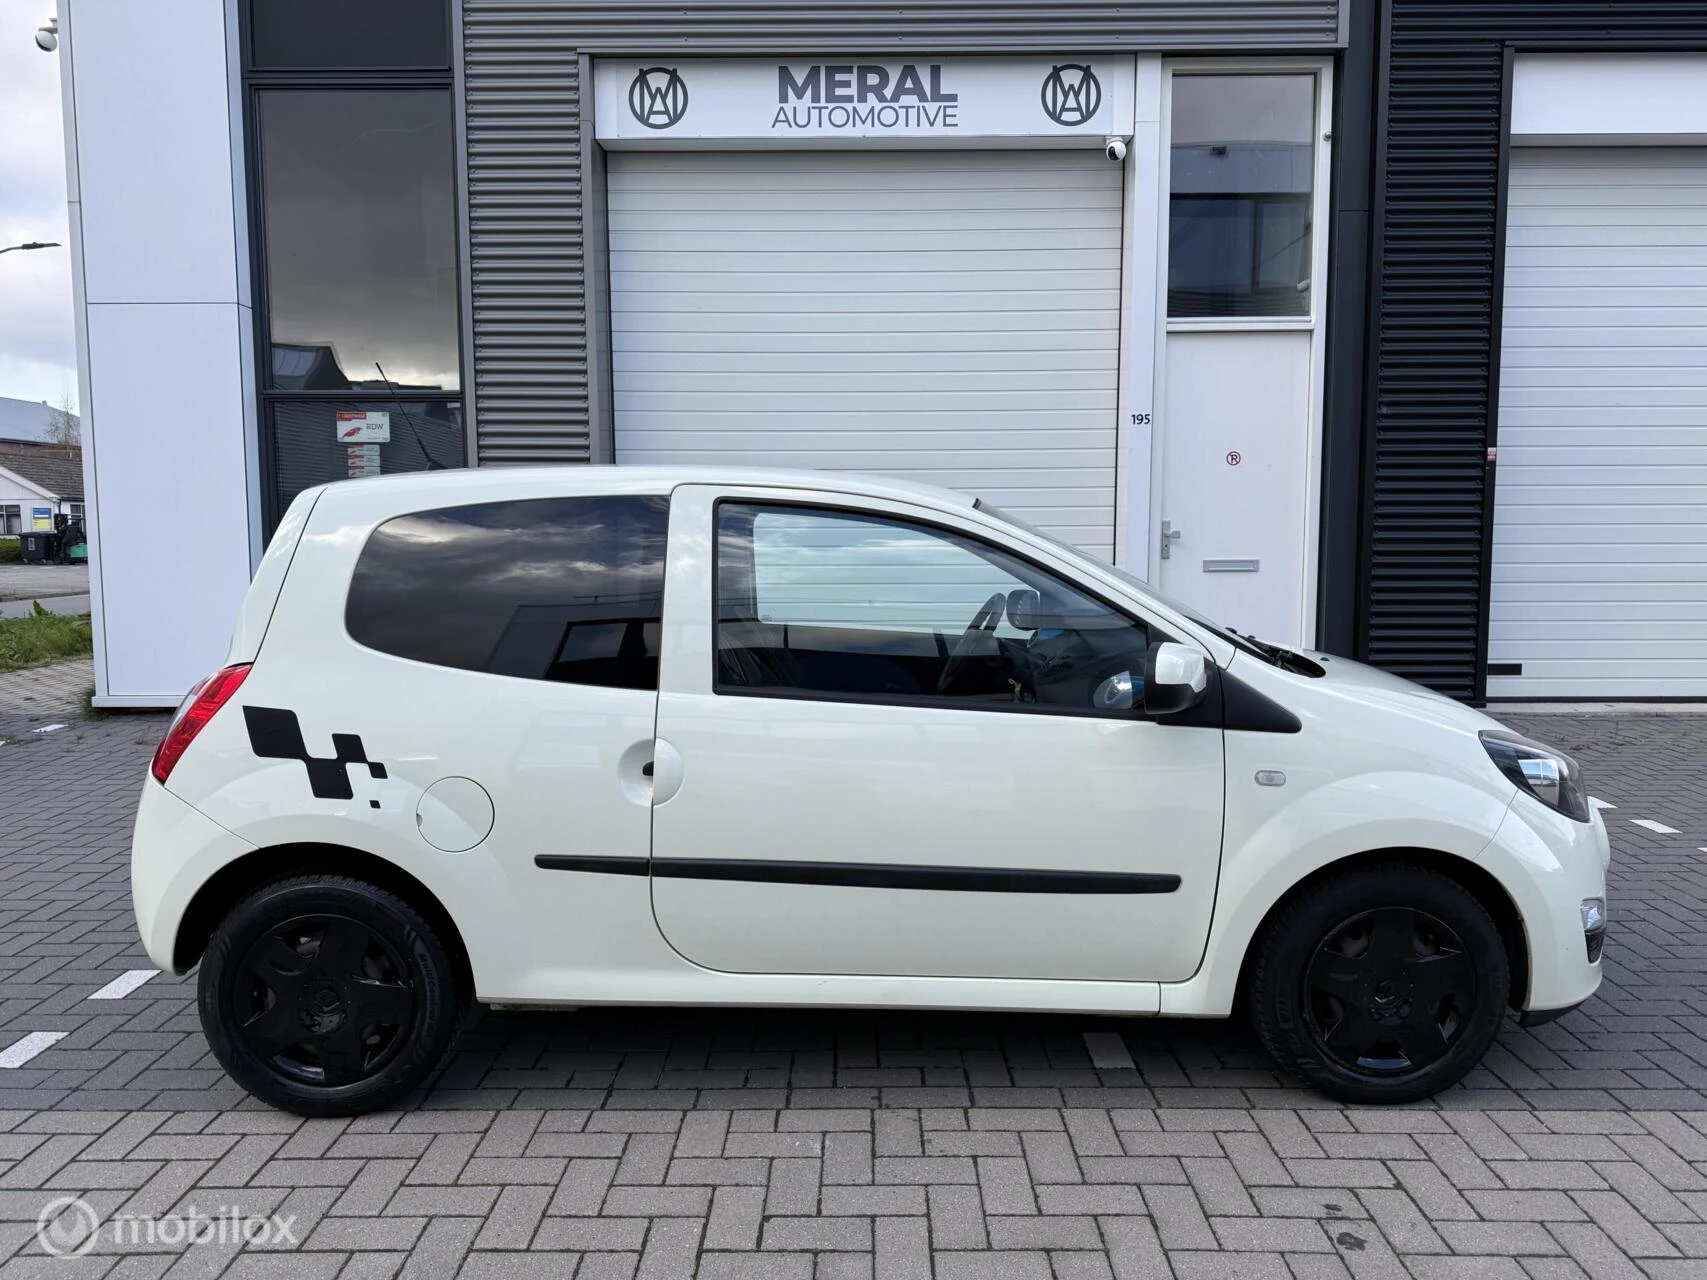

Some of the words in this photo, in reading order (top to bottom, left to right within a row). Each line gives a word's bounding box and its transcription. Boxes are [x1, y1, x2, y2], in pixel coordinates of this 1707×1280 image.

[778, 64, 958, 104] MERAL
[771, 105, 959, 128] AUTOMOTIVE
[1131, 413, 1151, 425] 195
